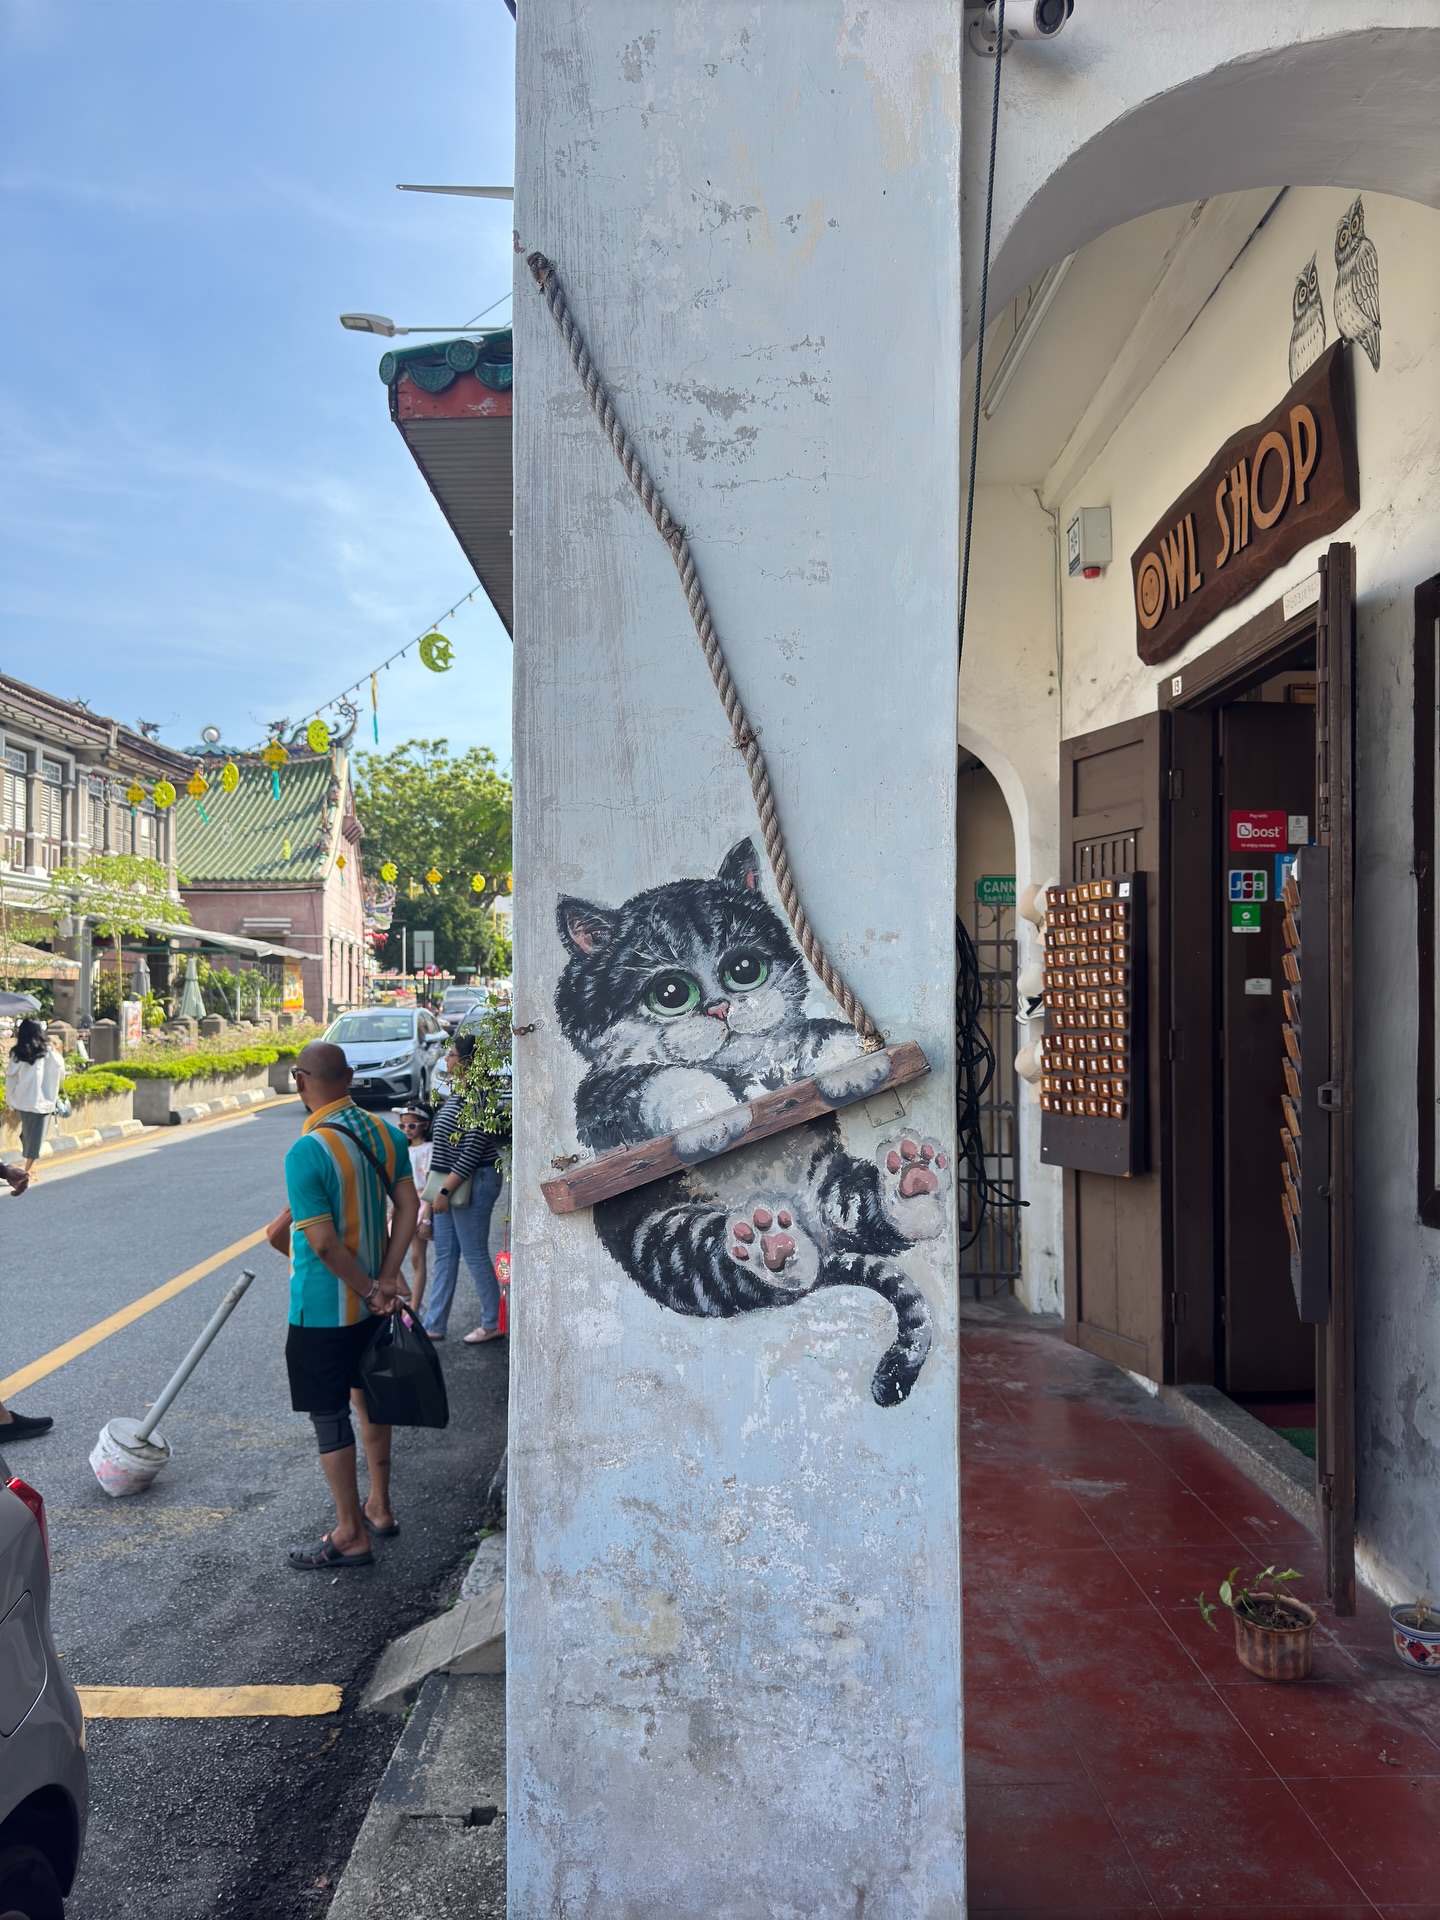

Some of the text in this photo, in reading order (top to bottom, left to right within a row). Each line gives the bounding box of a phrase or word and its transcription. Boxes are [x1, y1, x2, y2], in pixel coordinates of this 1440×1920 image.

[1136, 404, 1317, 629] OWL SHOP
[1230, 880, 1264, 891] JCB
